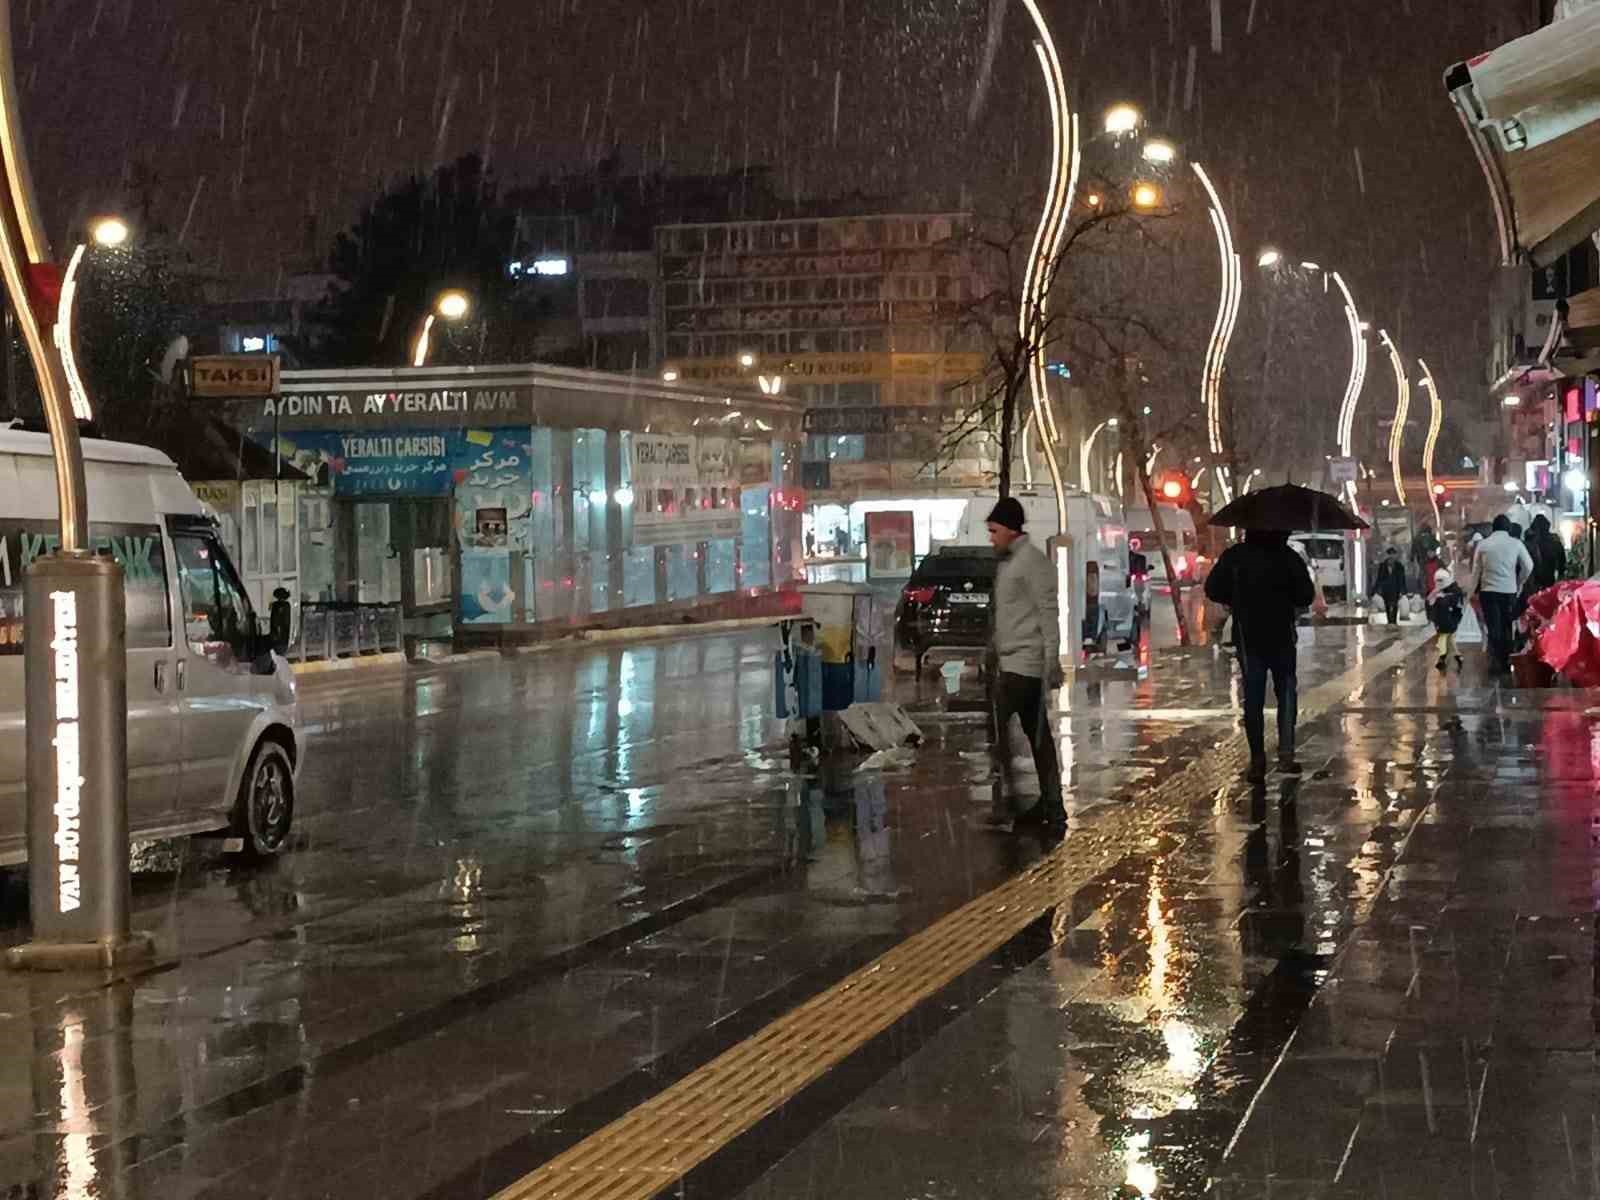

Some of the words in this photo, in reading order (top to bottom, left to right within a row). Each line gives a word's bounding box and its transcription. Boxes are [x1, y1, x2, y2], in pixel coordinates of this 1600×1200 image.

[263, 394, 322, 417] AYDIN
[388, 389, 468, 412] YERALTI
[473, 390, 517, 410] AVM
[341, 437, 391, 458] YERALTI
[59, 863, 81, 913] VAN
